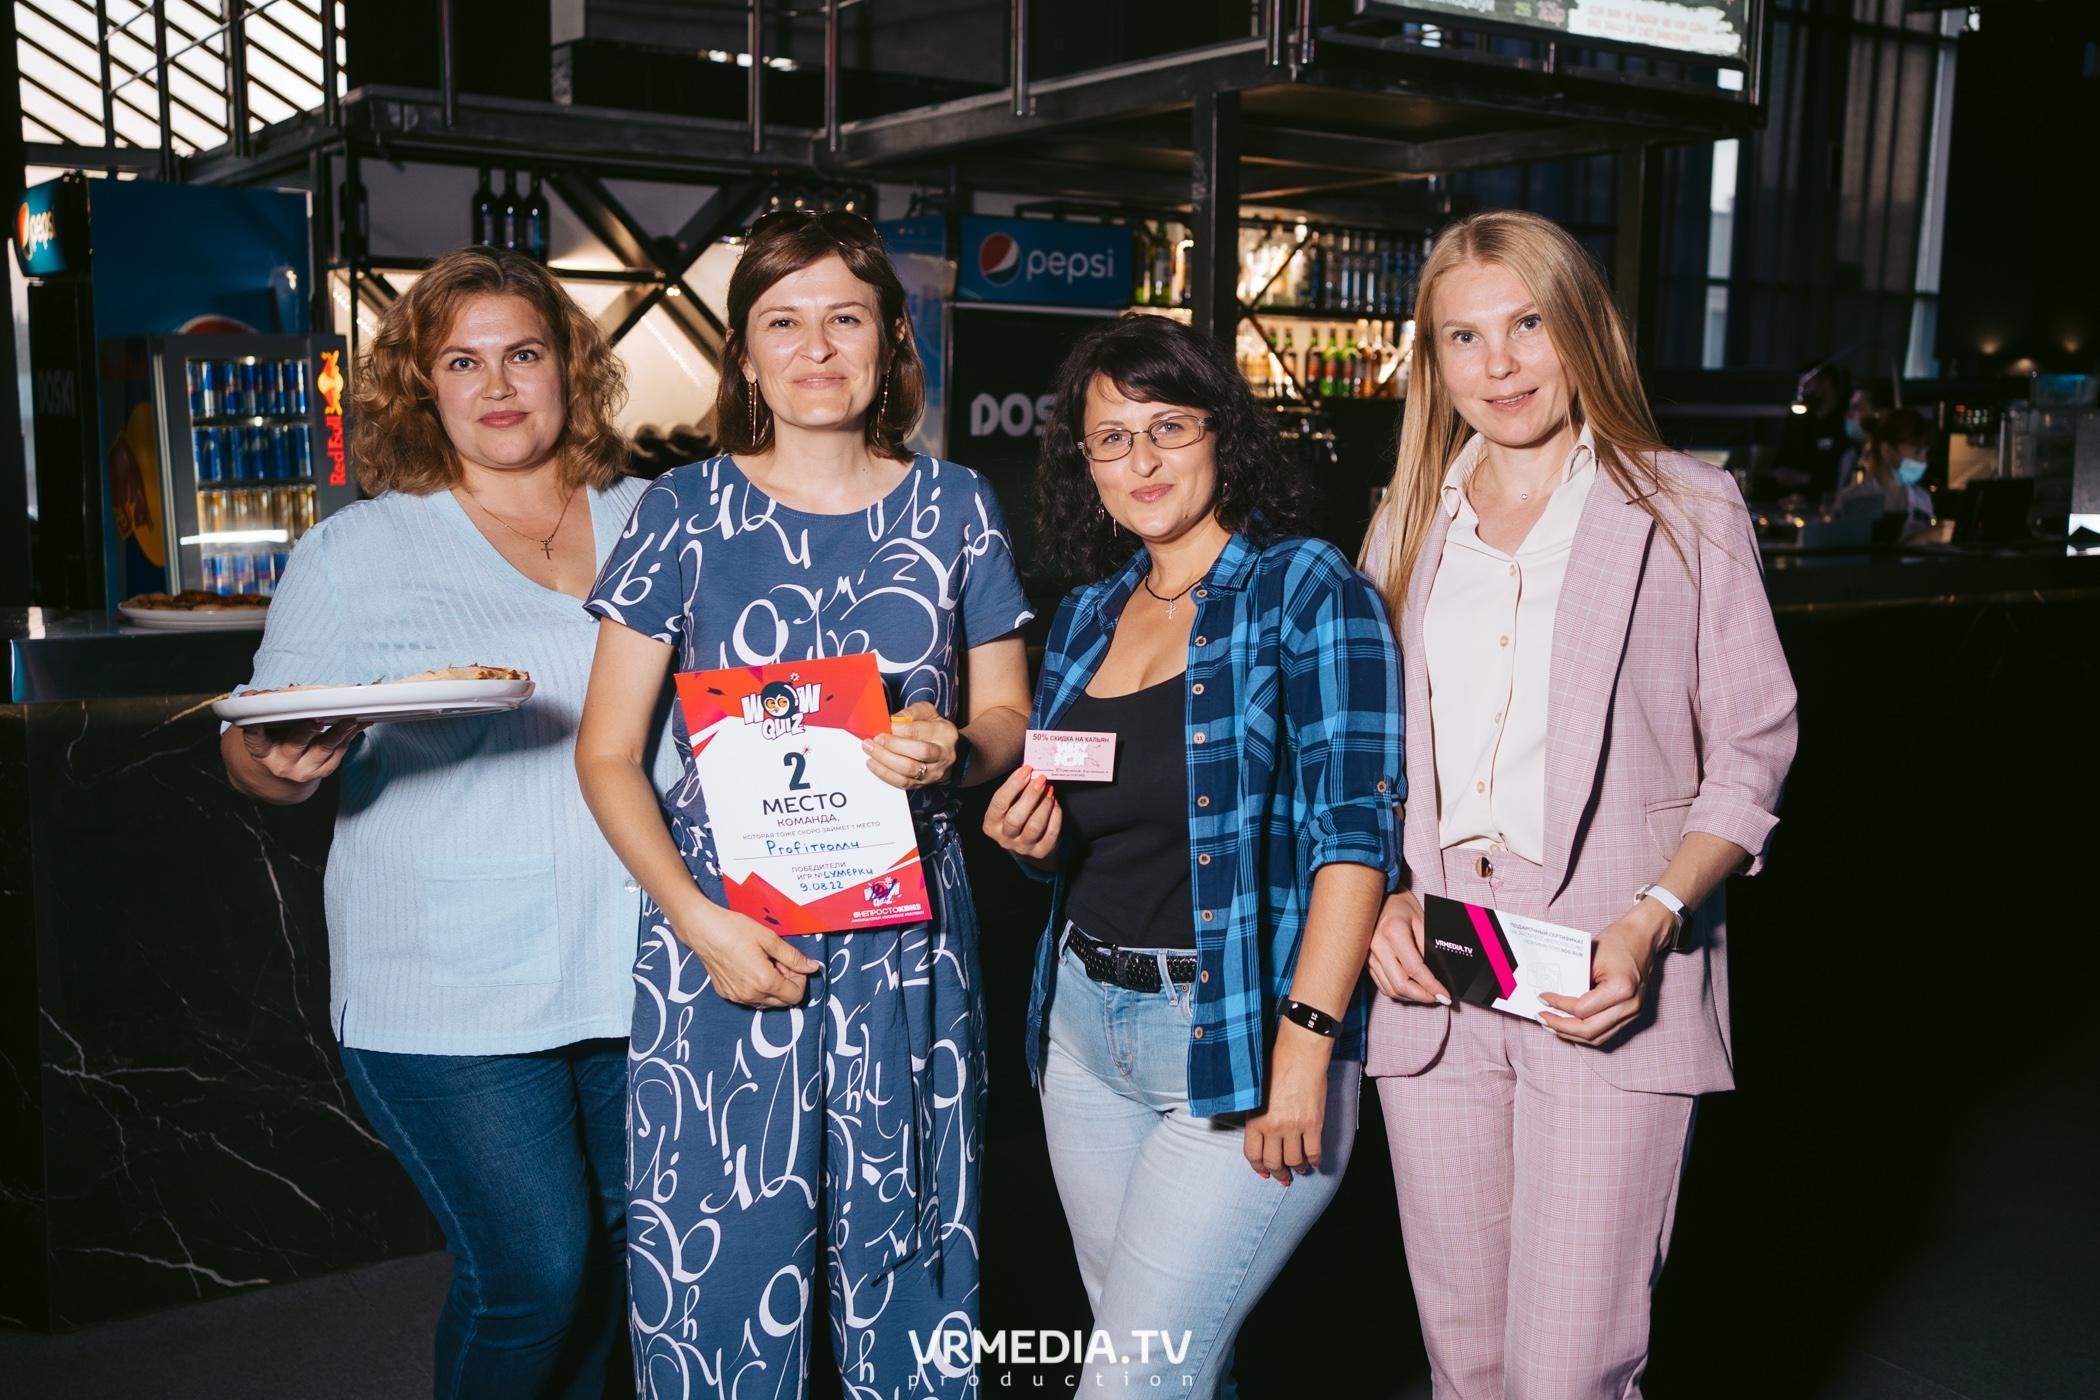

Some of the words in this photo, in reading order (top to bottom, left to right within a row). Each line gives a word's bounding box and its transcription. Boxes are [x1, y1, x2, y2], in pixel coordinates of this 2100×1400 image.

[30, 210, 56, 250] peps
[1026, 248, 1115, 284] pepsi
[324, 415, 344, 449] Bull
[328, 449, 347, 486] Red
[762, 712, 806, 741] QUIZ
[1032, 733, 1049, 742] 50%
[1085, 736, 1110, 744] КАЛЬЯН
[783, 751, 811, 791] 2
[763, 791, 848, 816] МЕСТО
[742, 833, 775, 841] КОТОРАЯ
[797, 828, 821, 836] СКОРО
[856, 821, 881, 829] МЕСТО
[777, 814, 841, 828] КОМАНДА,
[791, 861, 847, 873] ПОБЕДИТЕЛИ
